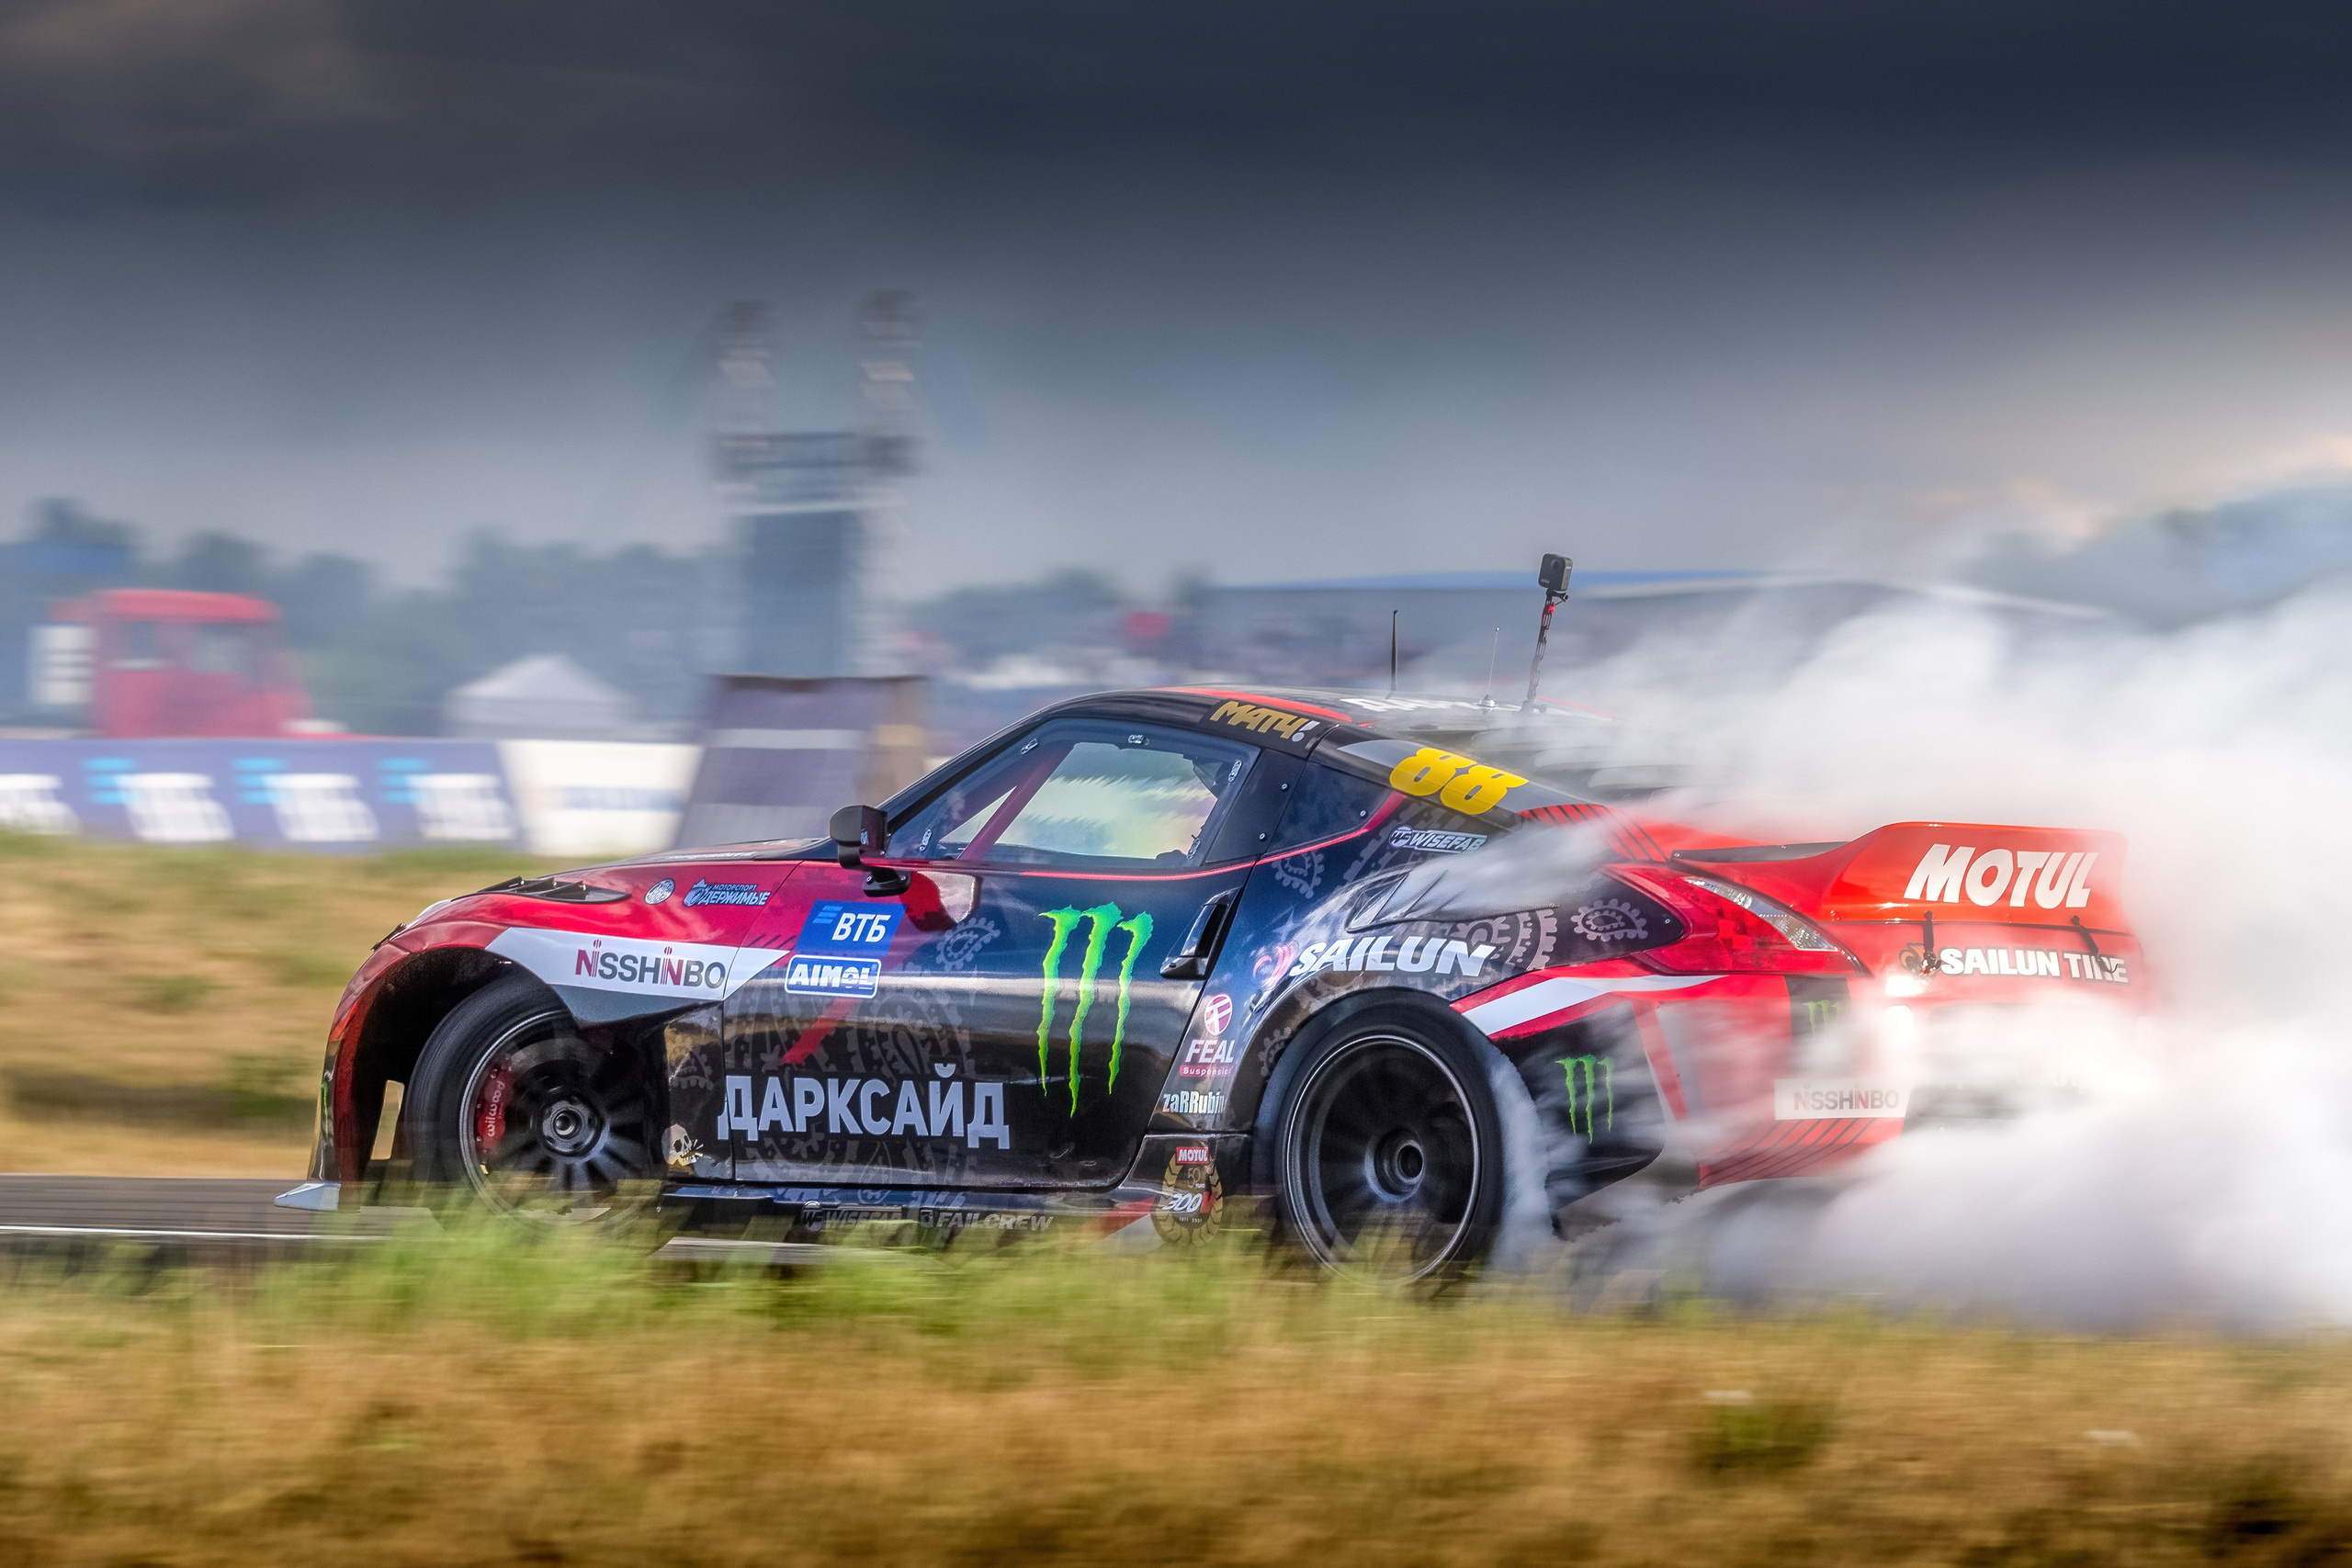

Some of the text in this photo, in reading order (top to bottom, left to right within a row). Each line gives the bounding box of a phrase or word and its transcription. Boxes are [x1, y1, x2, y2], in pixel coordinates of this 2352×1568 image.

[1389, 747, 1529, 815] 88
[1409, 832, 1487, 851] WISEFAB
[1904, 843, 2099, 908] MOTUL
[831, 912, 891, 942] ВТБ
[1288, 935, 1496, 977] SAILUN
[1939, 948, 2060, 977] SAILUN
[788, 964, 875, 989] AIMOL
[1185, 1039, 1235, 1064] FEAL
[485, 1080, 505, 1137] wilwood
[717, 1063, 1011, 1150] ДАРКСАЙД
[1178, 1148, 1208, 1162] MOTUL
[937, 1212, 1054, 1231] FAILCREW
